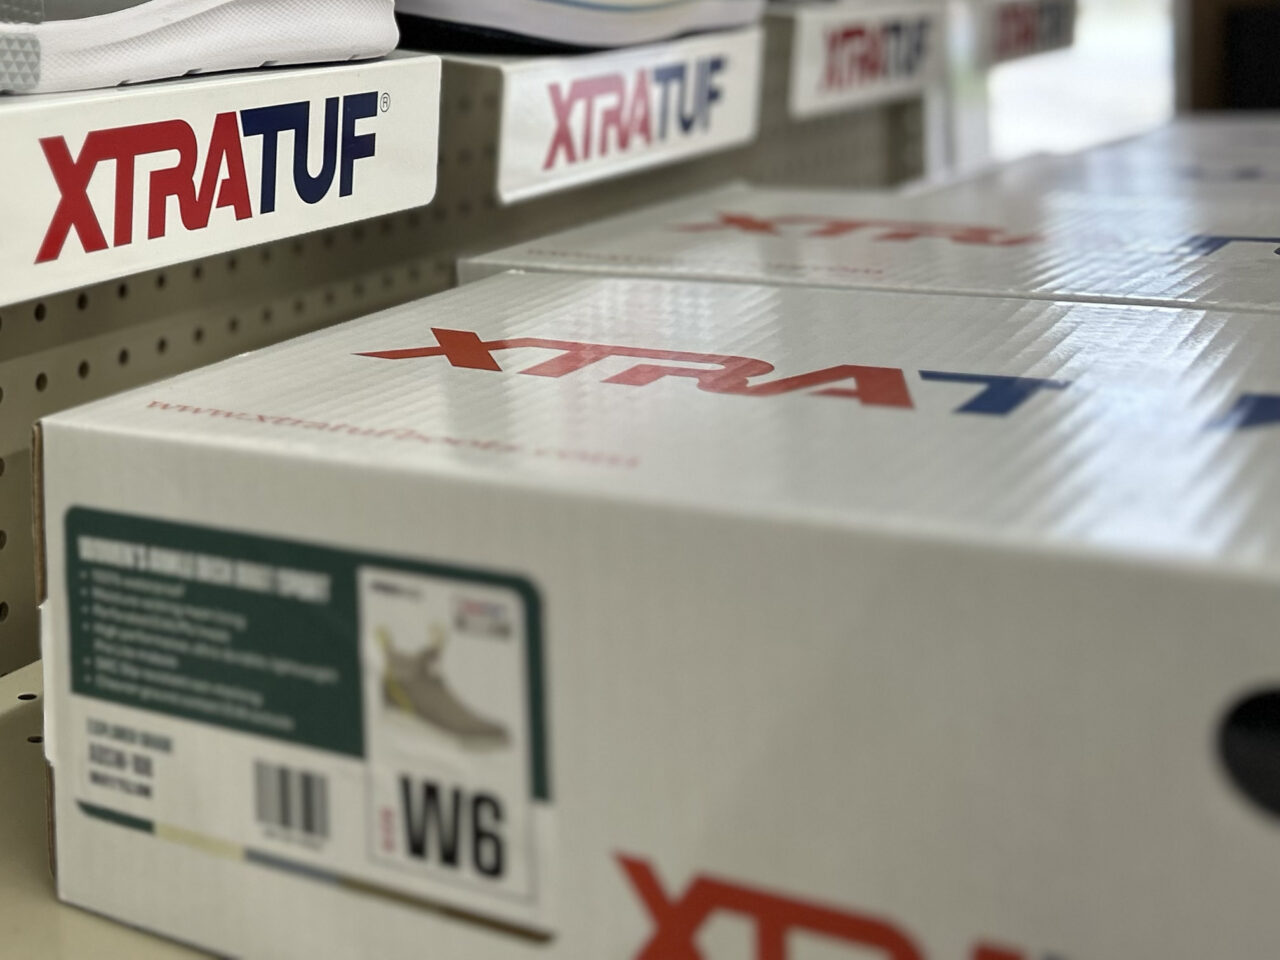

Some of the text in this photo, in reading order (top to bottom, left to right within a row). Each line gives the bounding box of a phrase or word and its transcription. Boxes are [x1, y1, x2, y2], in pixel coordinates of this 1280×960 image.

[543, 57, 728, 171] XTRATUF
[34, 91, 379, 265] XTRATUF
[400, 774, 504, 878] W6
